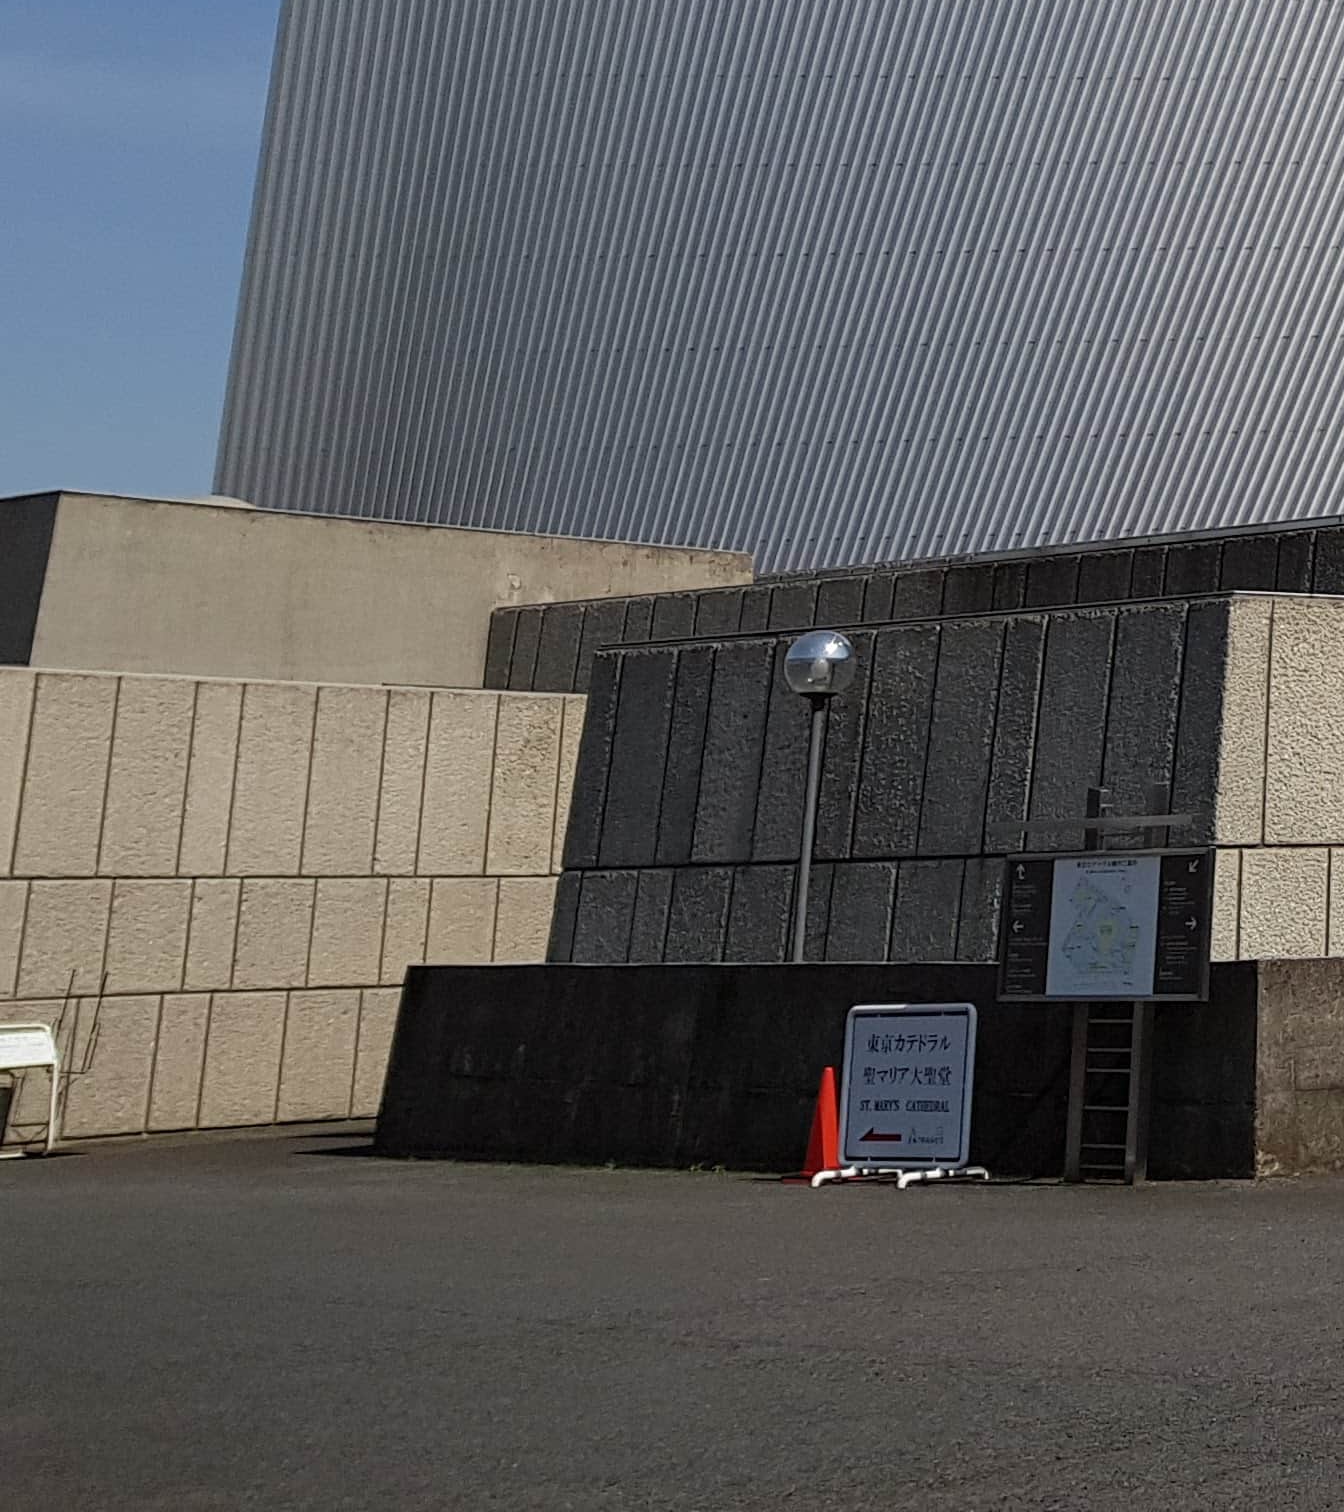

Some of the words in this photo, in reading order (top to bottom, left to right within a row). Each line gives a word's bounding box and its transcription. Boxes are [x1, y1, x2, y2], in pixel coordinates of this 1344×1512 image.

[866, 1033, 951, 1053] 東京カテドラル
[863, 1065, 952, 1086] 聖マリア大聖堂
[905, 1099, 950, 1113] CATHEDRAL
